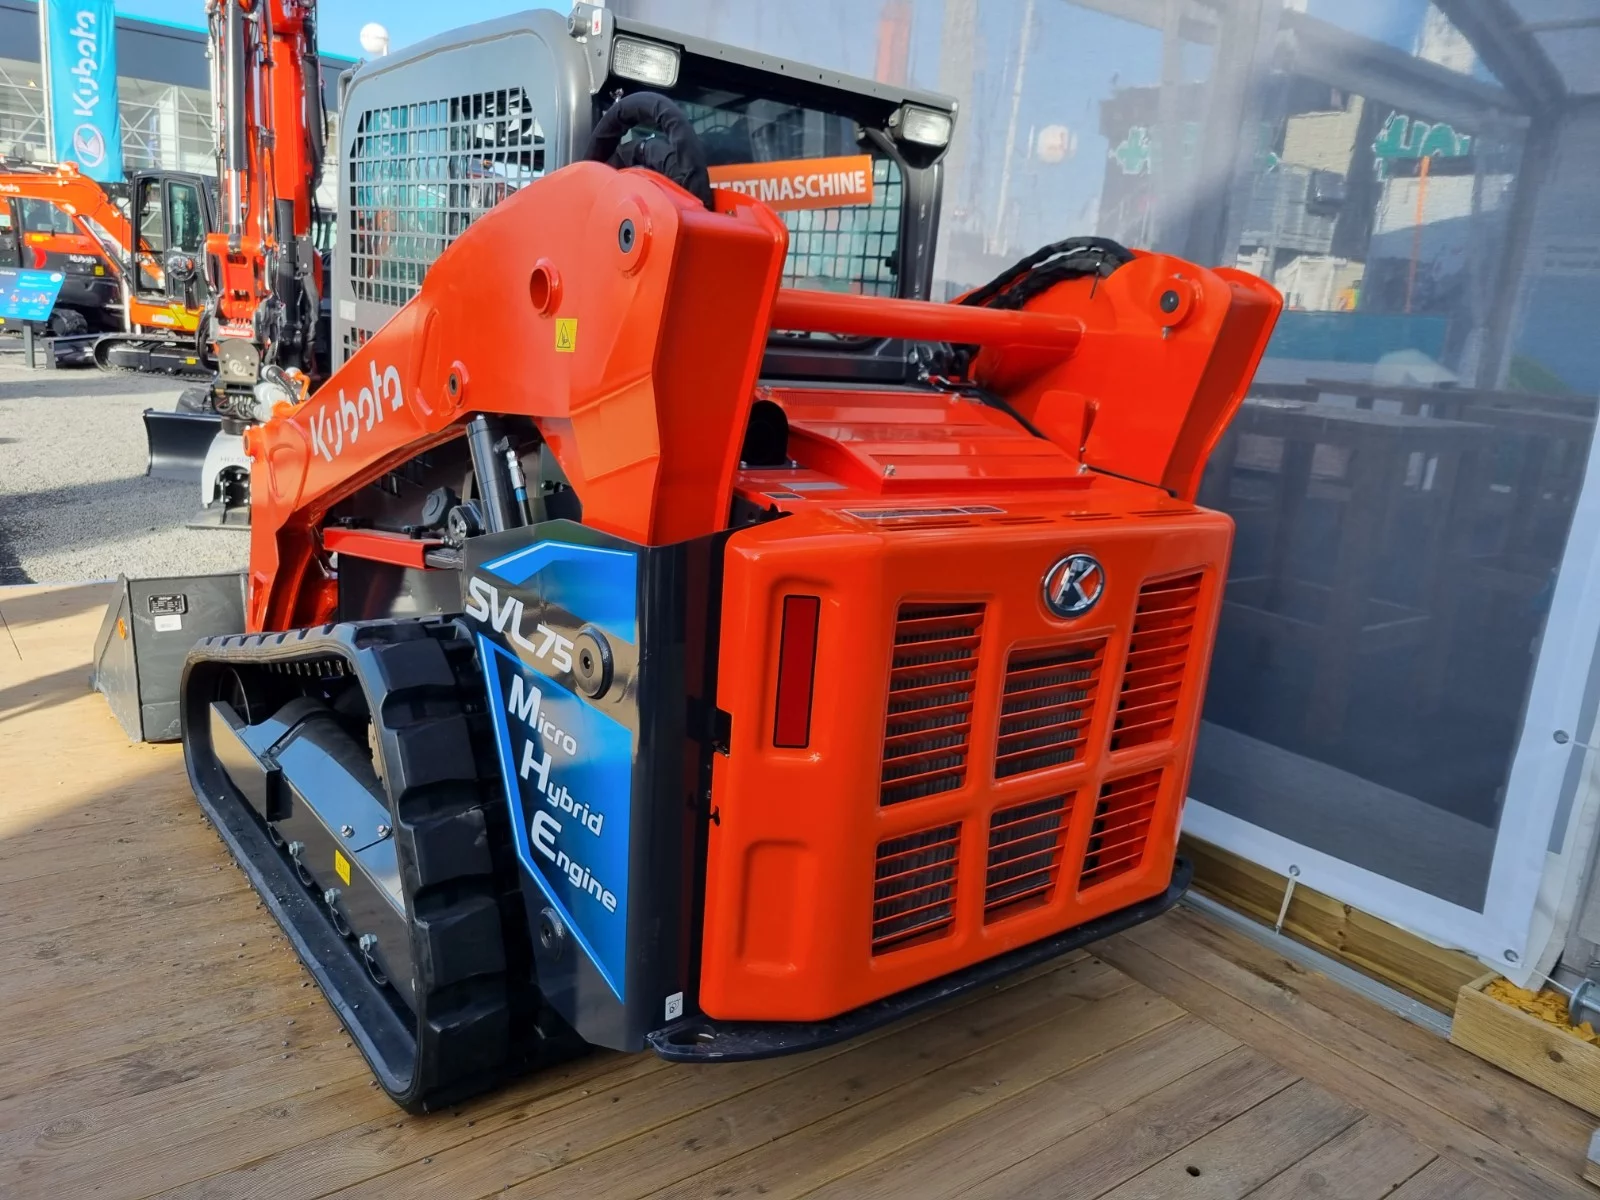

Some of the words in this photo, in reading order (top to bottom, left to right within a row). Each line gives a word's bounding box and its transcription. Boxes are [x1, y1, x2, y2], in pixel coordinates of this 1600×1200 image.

[70, 10, 100, 117] Kubota
[309, 359, 404, 462] Kubota
[508, 673, 577, 756] Micro
[520, 738, 604, 836] Hybrid
[531, 809, 617, 913] Engine
